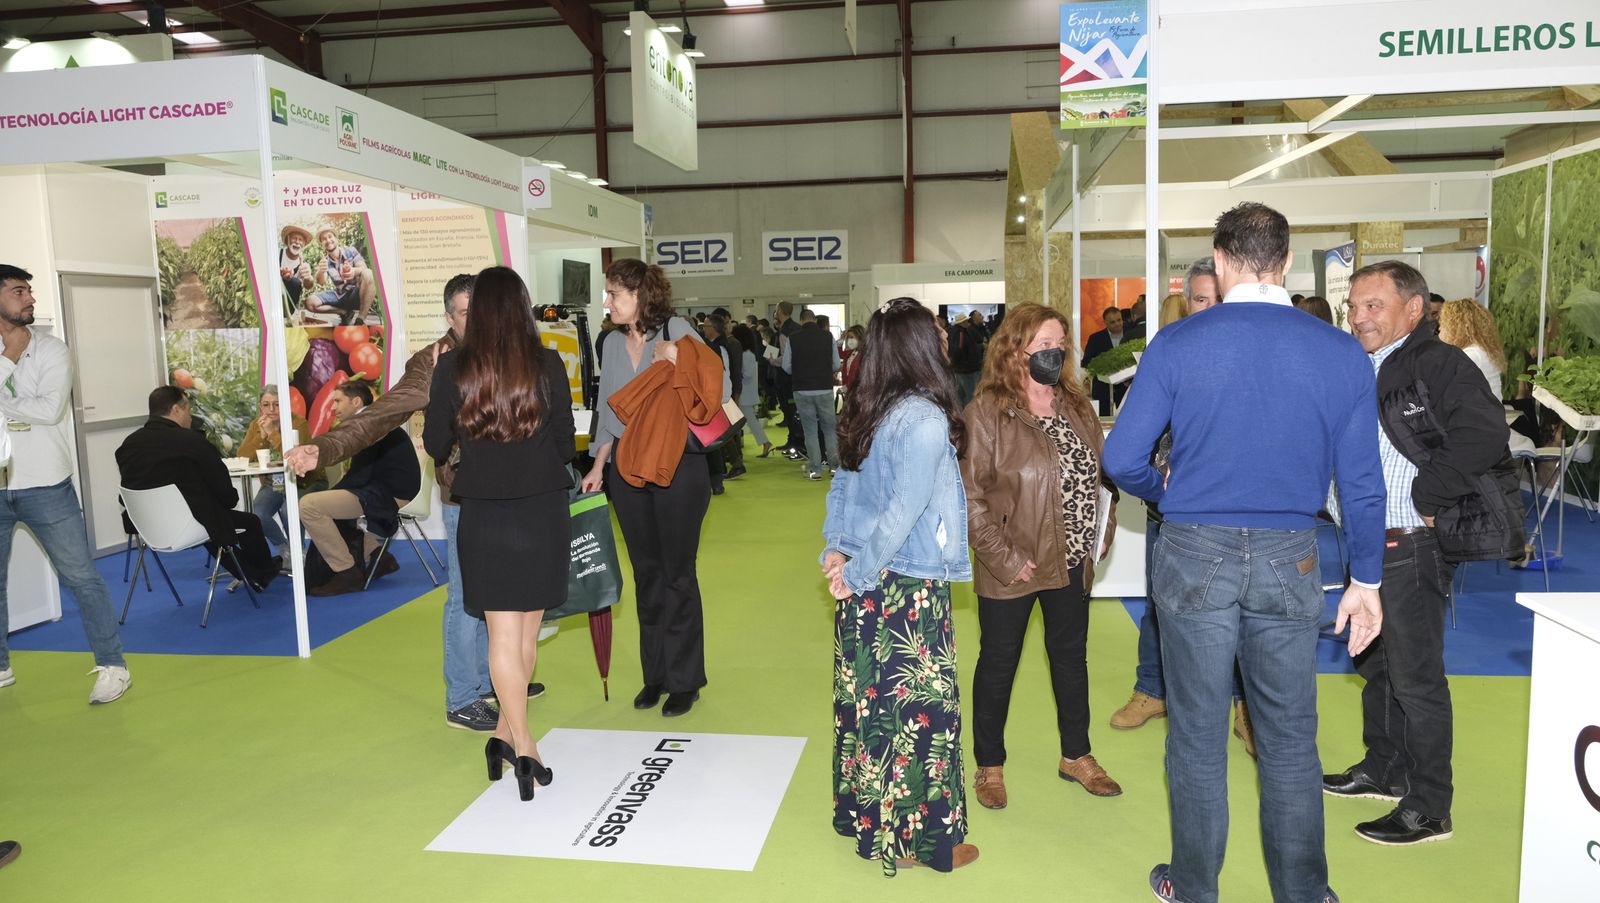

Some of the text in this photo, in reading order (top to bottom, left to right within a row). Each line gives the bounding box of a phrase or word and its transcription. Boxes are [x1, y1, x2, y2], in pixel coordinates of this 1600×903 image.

[1378, 22, 1576, 58] SEMILLEROS
[649, 46, 693, 102] entonova
[0, 108, 98, 129] TECNOLOGÍA
[101, 107, 146, 123] LIGHT
[290, 104, 330, 126] CASCADE
[362, 137, 380, 150] FILMS
[412, 151, 431, 166] MAGIC
[436, 158, 448, 171] LITE
[448, 164, 459, 175] CON
[284, 196, 362, 207] EN TU CULTIVO
[302, 186, 338, 195] MEJOR
[342, 184, 362, 193] LUZ
[656, 239, 728, 265] SER
[769, 236, 842, 262] SER
[588, 757, 673, 848] greenvass
